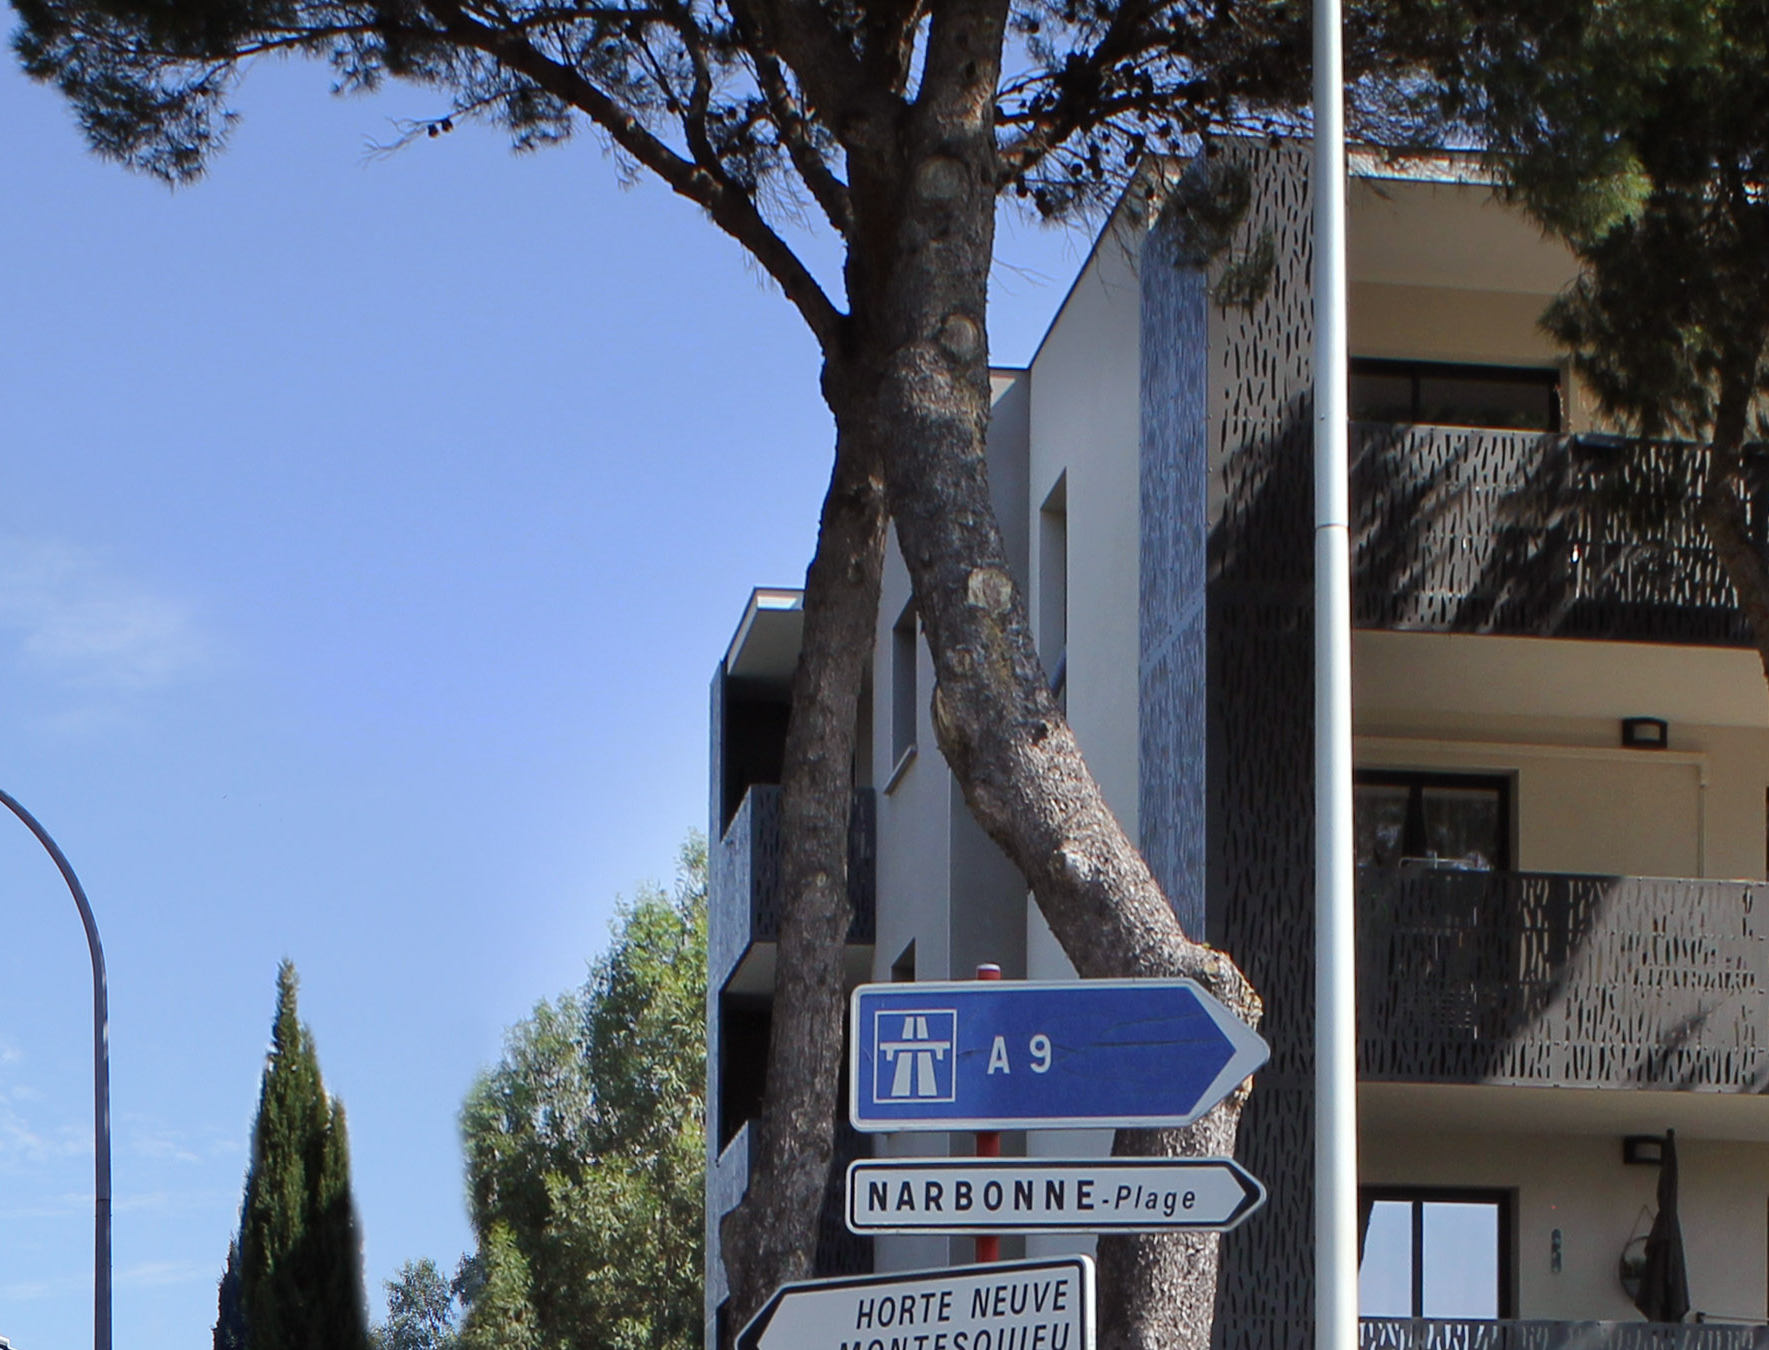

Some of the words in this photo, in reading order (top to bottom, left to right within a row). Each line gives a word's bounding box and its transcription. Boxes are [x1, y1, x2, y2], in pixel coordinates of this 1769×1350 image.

[987, 1036, 1010, 1075] A
[1029, 1034, 1053, 1074] 9
[868, 1179, 1196, 1217] NARBONNE-Plage
[856, 1291, 953, 1330] HORTE
[971, 1279, 1069, 1319] NEUVE
